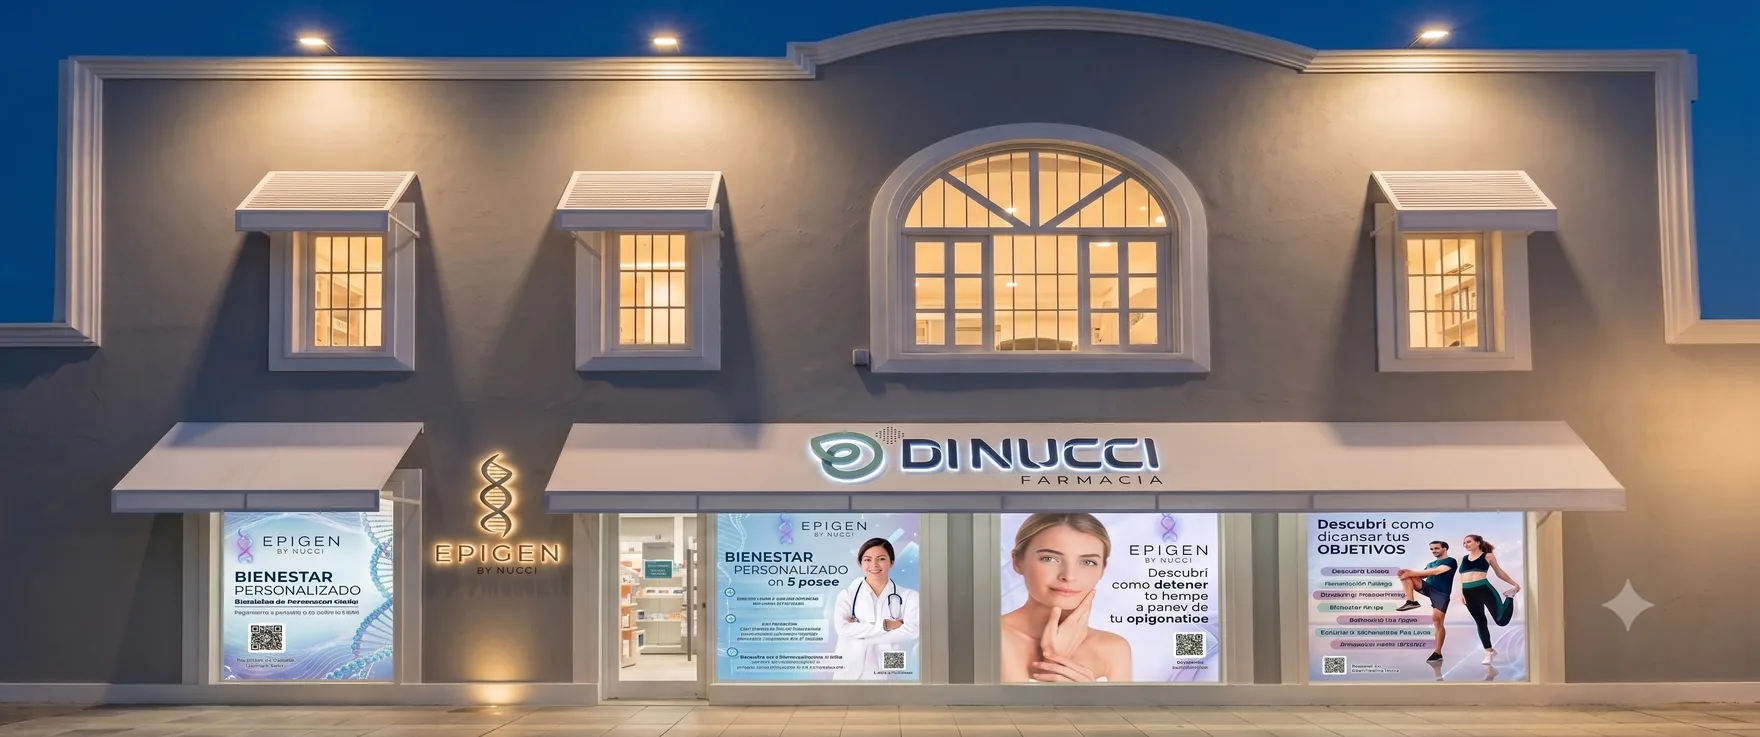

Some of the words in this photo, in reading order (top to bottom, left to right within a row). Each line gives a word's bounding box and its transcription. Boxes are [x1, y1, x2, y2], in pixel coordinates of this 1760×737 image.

[1021, 475, 1163, 485] FARMACIA
[801, 521, 867, 531] EPIGEN
[1317, 518, 1386, 530] Descubrí
[1391, 521, 1434, 530] como
[263, 536, 340, 547] EPIGEN
[1317, 531, 1383, 542] dicansar
[1386, 532, 1410, 542] tus
[435, 544, 560, 562] EPIGEN
[1129, 545, 1209, 556] EPIGEN
[1317, 544, 1406, 555] OBJETIVOS
[725, 552, 814, 563] BIENESTAR
[477, 566, 492, 575] BY
[497, 566, 537, 575] NUCCI
[734, 565, 849, 575] PERSONALIZADO
[1148, 568, 1208, 578] Descubrí
[235, 571, 333, 583] BIENESTAR
[768, 579, 784, 587] on
[787, 577, 796, 587] 5
[798, 578, 840, 588] posee
[235, 585, 361, 596] PERSONALIZADO
[1112, 581, 1150, 590] como
[1154, 580, 1208, 590] detener
[1145, 591, 1158, 601] to
[1162, 591, 1208, 602] hempe
[1136, 604, 1144, 612] a
[1148, 604, 1188, 614] panev
[1191, 602, 1208, 612] de
[1110, 615, 1123, 624] tu
[1127, 613, 1209, 625] opigonatioe
